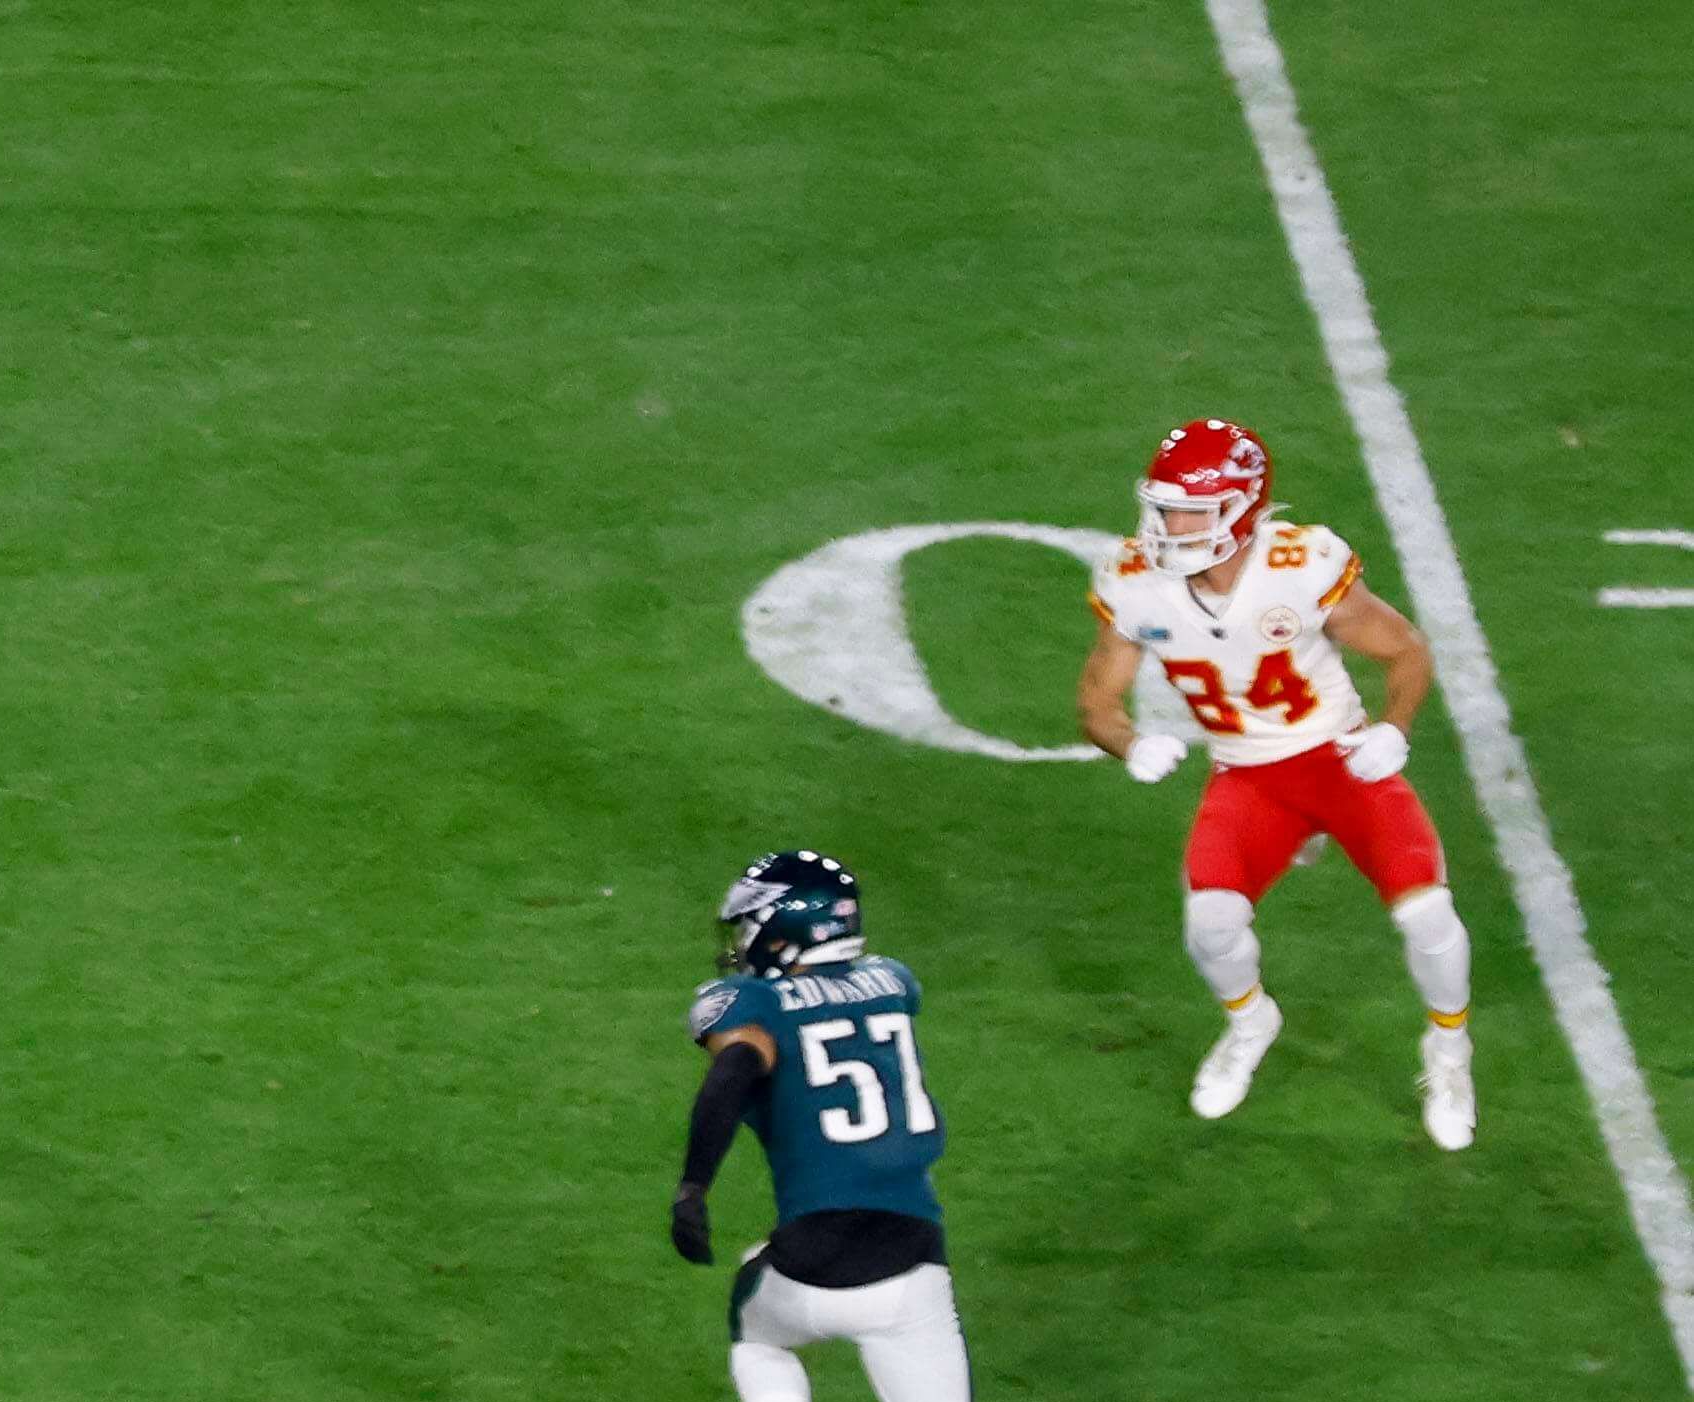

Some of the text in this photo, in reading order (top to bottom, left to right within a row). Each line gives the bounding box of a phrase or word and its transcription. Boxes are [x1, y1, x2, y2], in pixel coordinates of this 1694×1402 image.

[1162, 646, 1320, 736] 84
[772, 966, 908, 1012] EDWARD
[797, 1012, 937, 1143] 57
